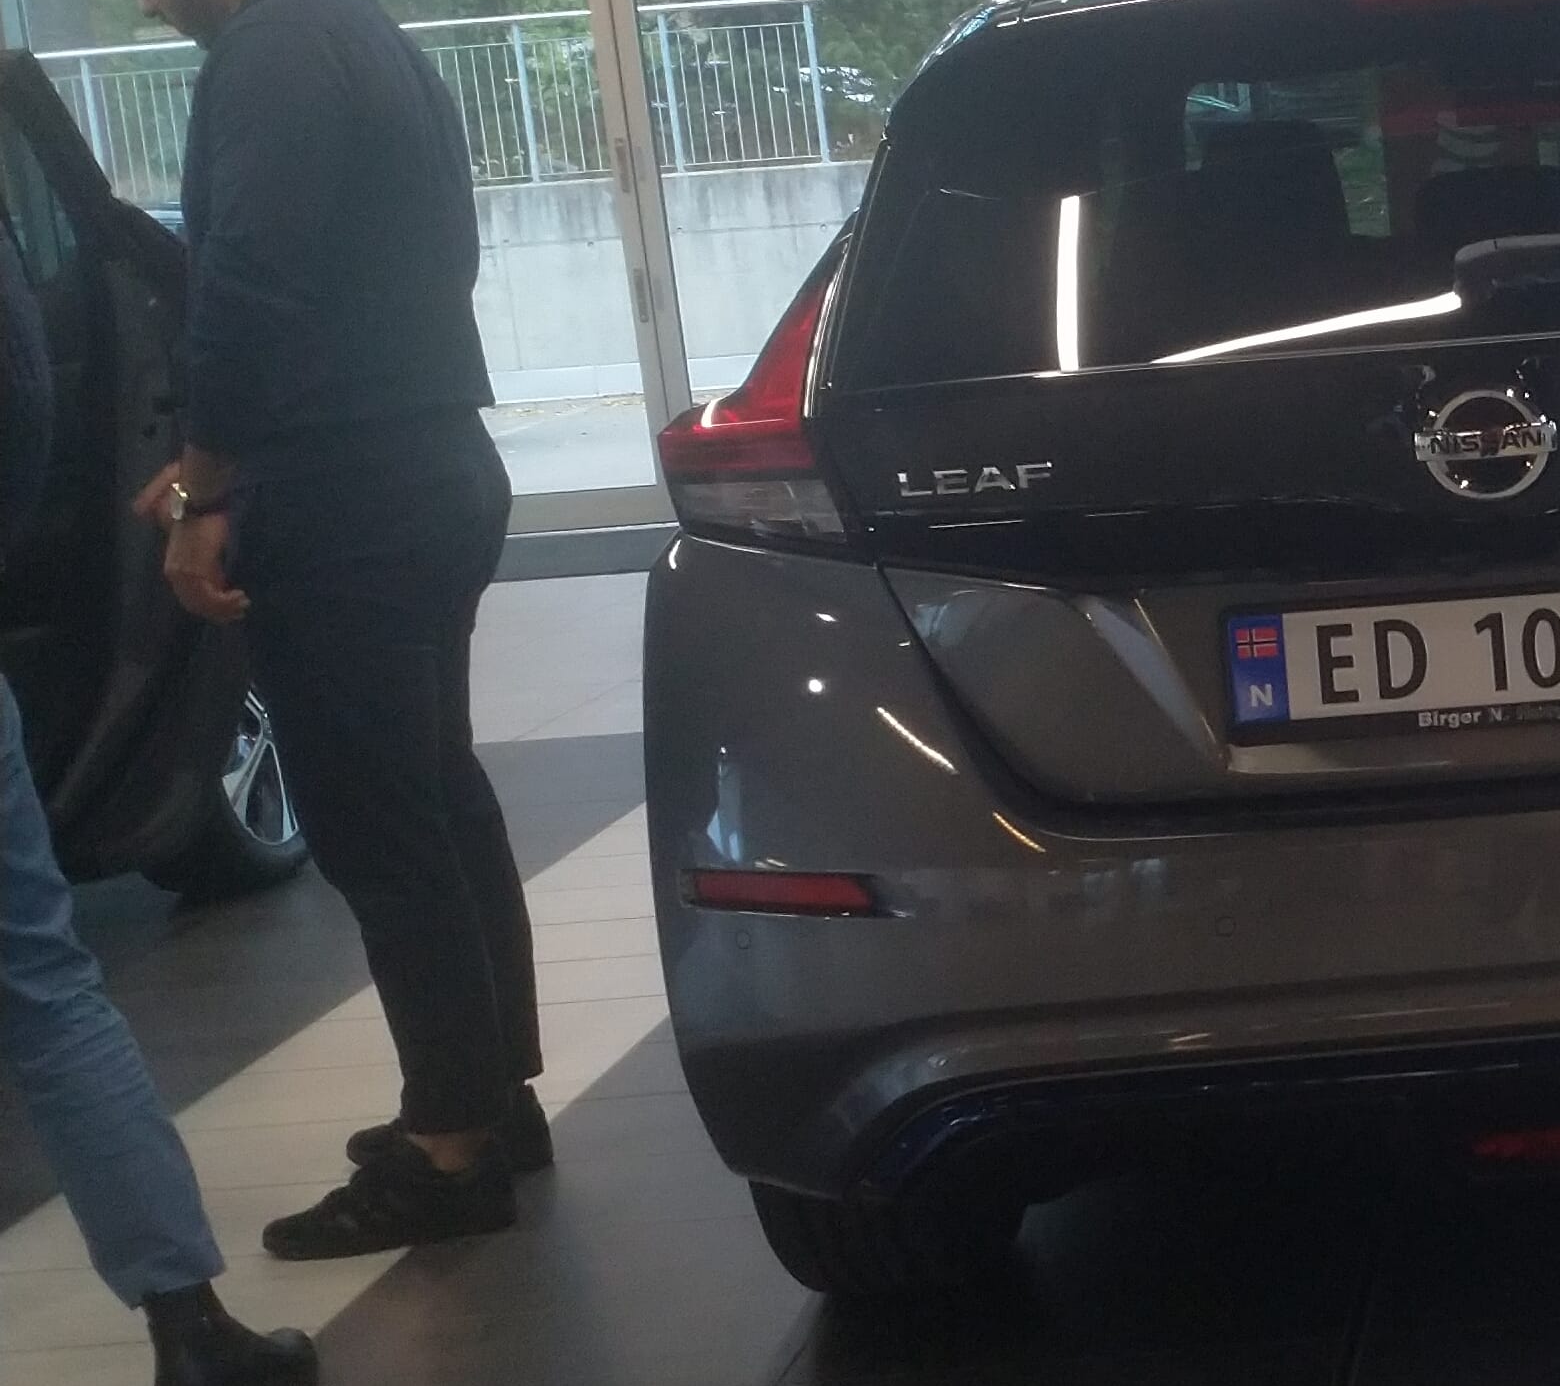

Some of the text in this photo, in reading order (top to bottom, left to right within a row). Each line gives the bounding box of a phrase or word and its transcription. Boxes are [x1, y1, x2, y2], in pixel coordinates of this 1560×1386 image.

[1430, 424, 1542, 455] NISAN
[897, 461, 1053, 497] LEAF
[1316, 619, 1428, 705] ED
[1250, 684, 1273, 708] N
[1418, 711, 1482, 729] Birger
